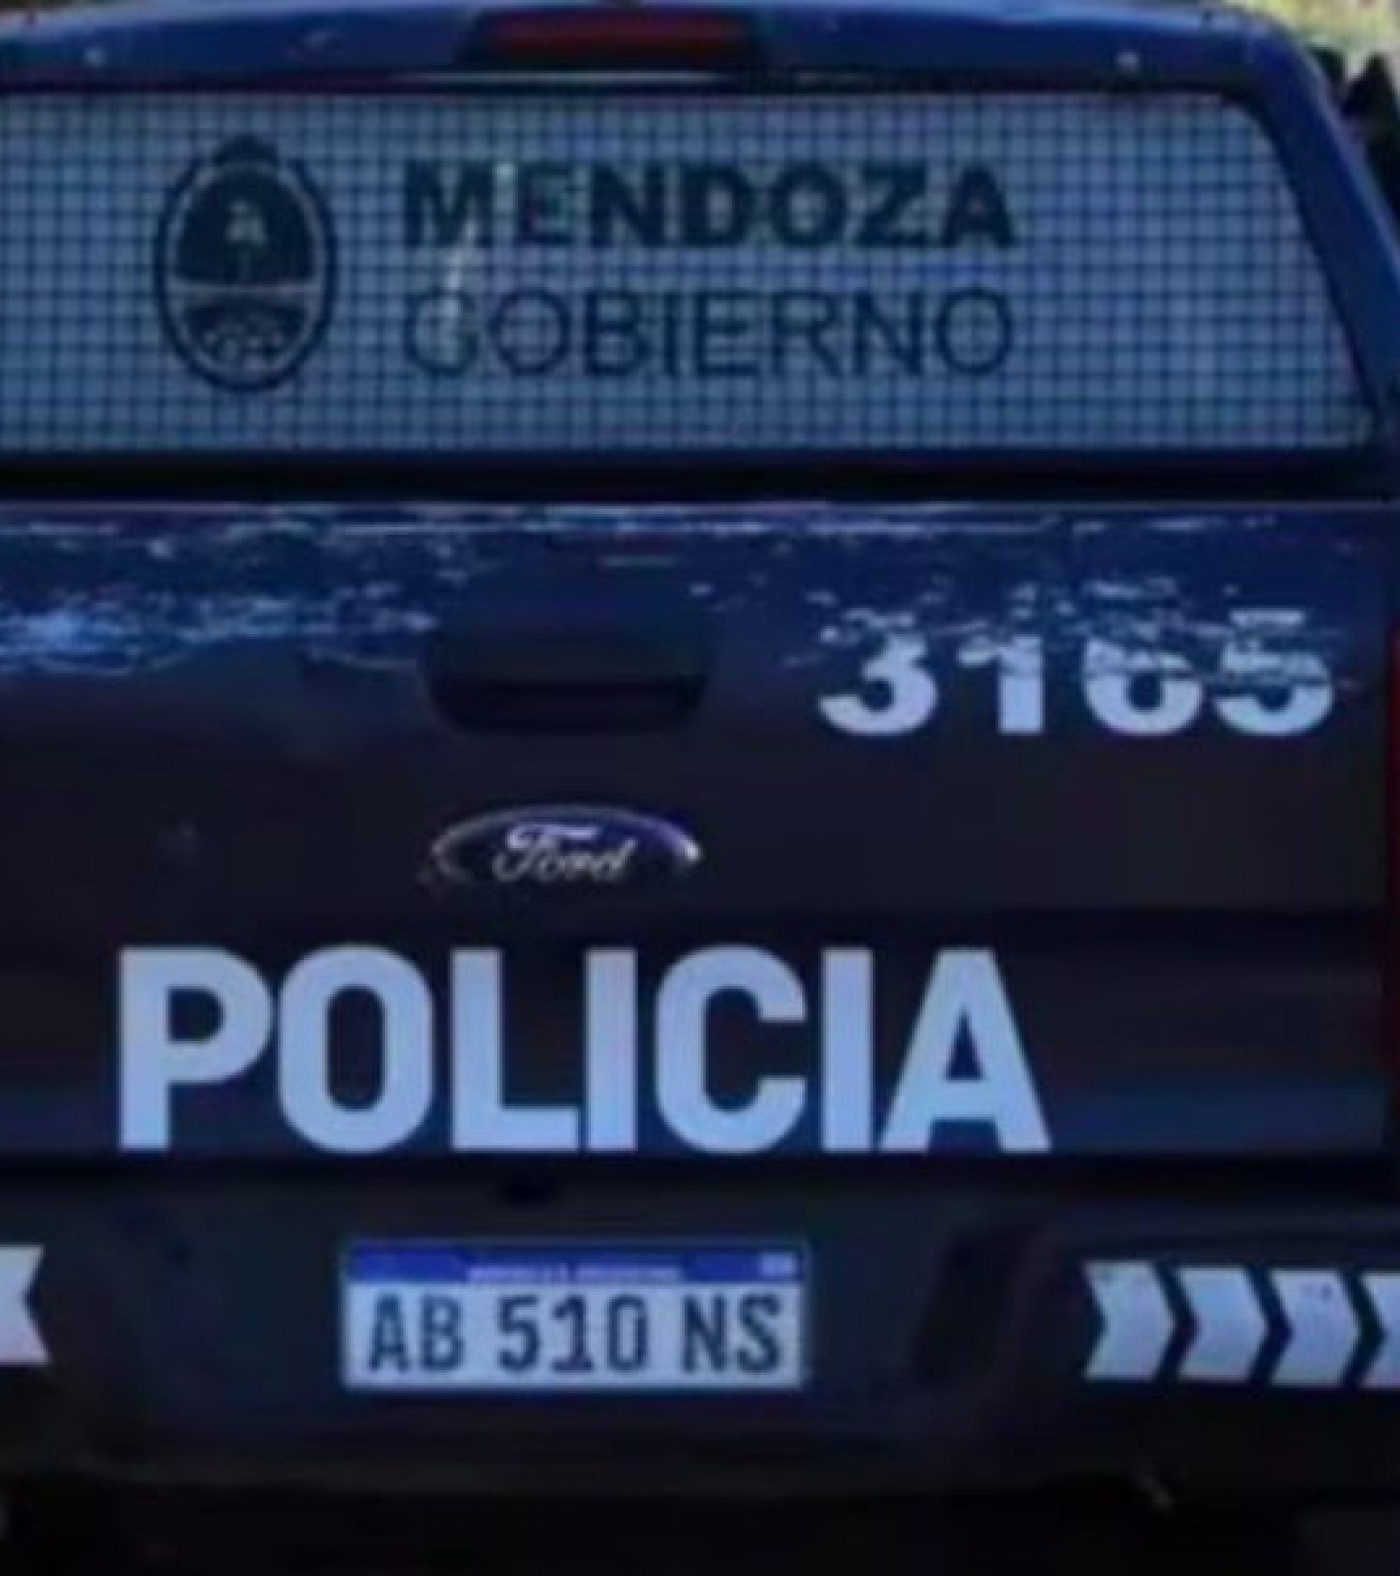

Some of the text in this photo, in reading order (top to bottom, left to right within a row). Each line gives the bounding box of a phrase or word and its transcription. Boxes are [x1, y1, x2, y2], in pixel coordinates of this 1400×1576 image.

[403, 159, 1015, 247] MENDOZA
[408, 288, 1014, 377] GOBIERNO
[818, 608, 1335, 735] 3165
[492, 822, 637, 883] Ford
[119, 945, 1051, 1153] POLICIA
[368, 1294, 783, 1374] AB 510 NS
